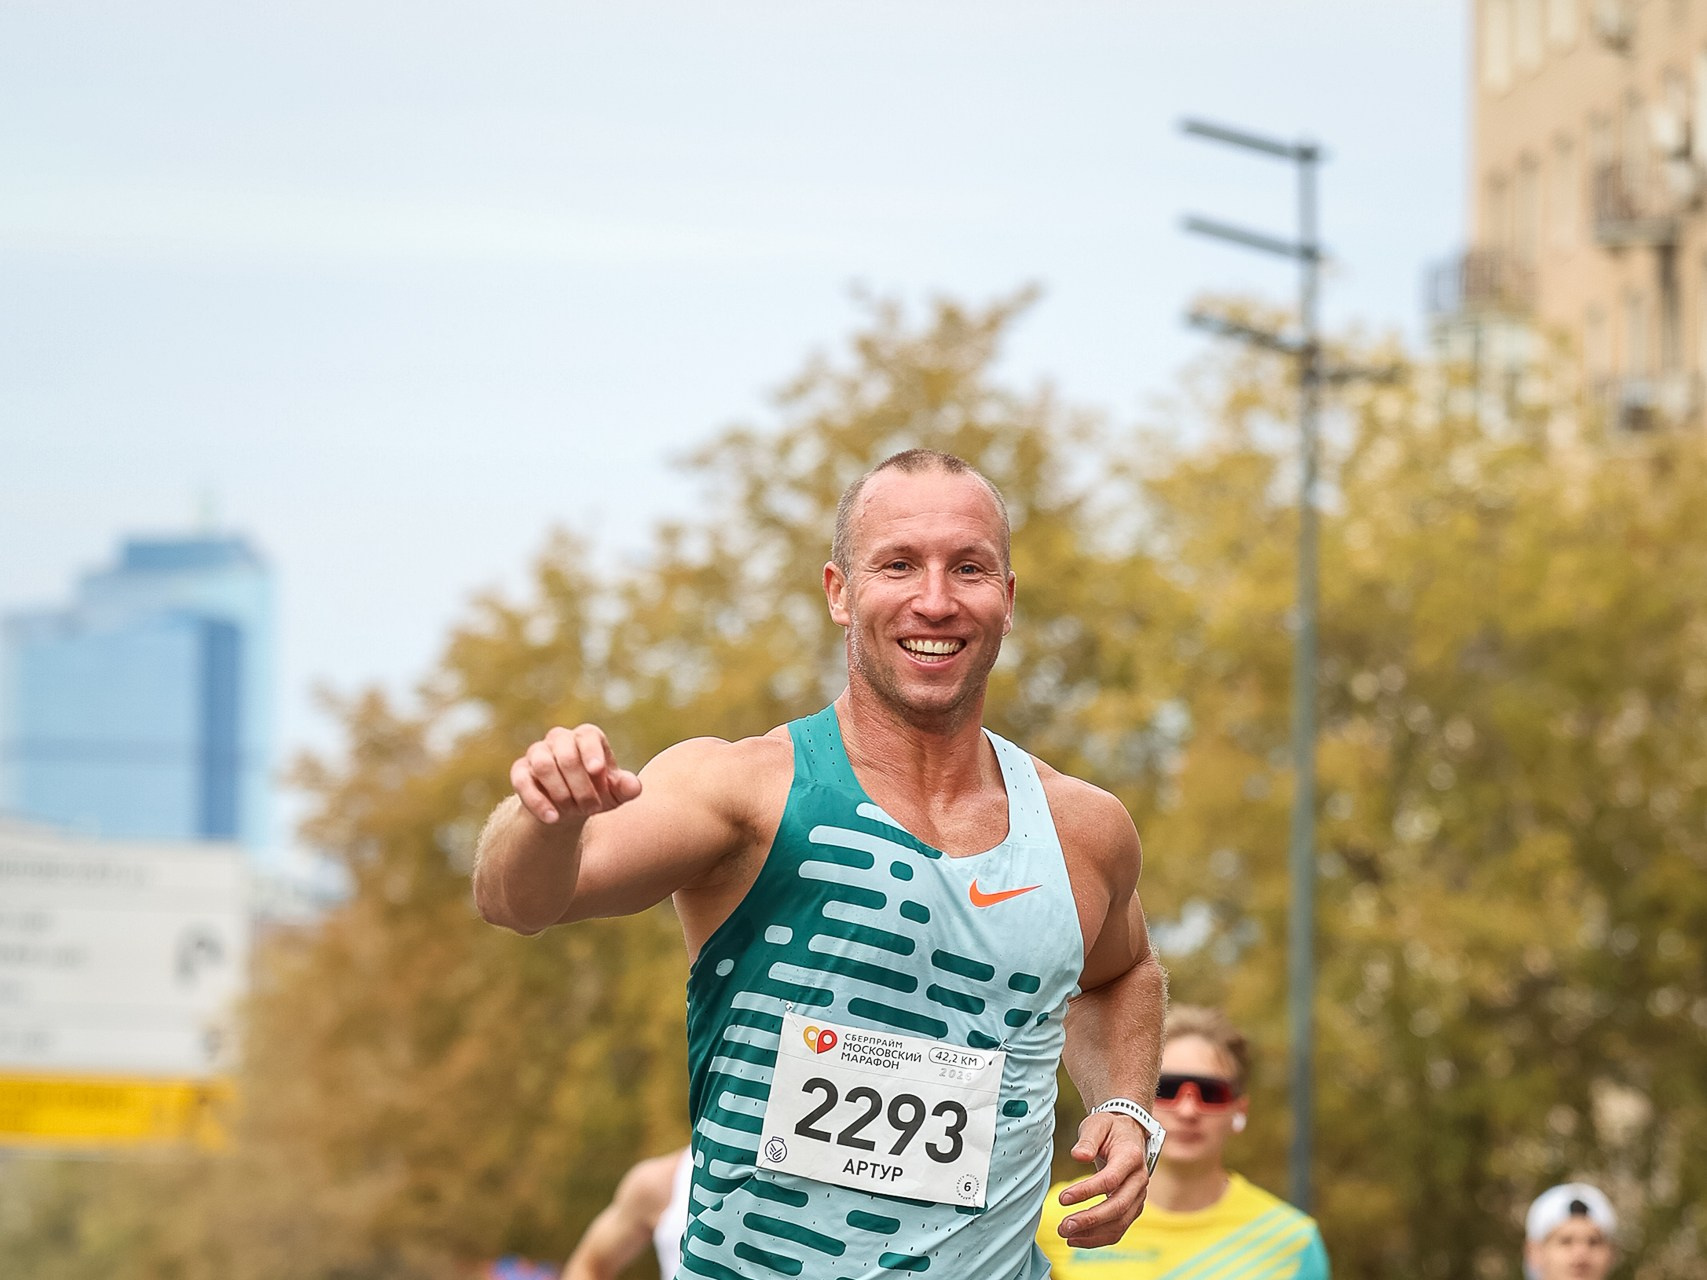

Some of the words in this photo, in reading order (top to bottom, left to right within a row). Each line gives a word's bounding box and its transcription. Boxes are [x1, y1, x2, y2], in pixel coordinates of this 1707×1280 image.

[845, 1033, 903, 1049] СБЕРПРАЙМ
[840, 1052, 900, 1070] МАРАФОН
[842, 1042, 922, 1062] МОСКОВСКИЙ
[935, 1051, 958, 1063] 42,2
[794, 1077, 968, 1164] 2293
[842, 1158, 904, 1182] АРТУР
[963, 1181, 972, 1192] 6
